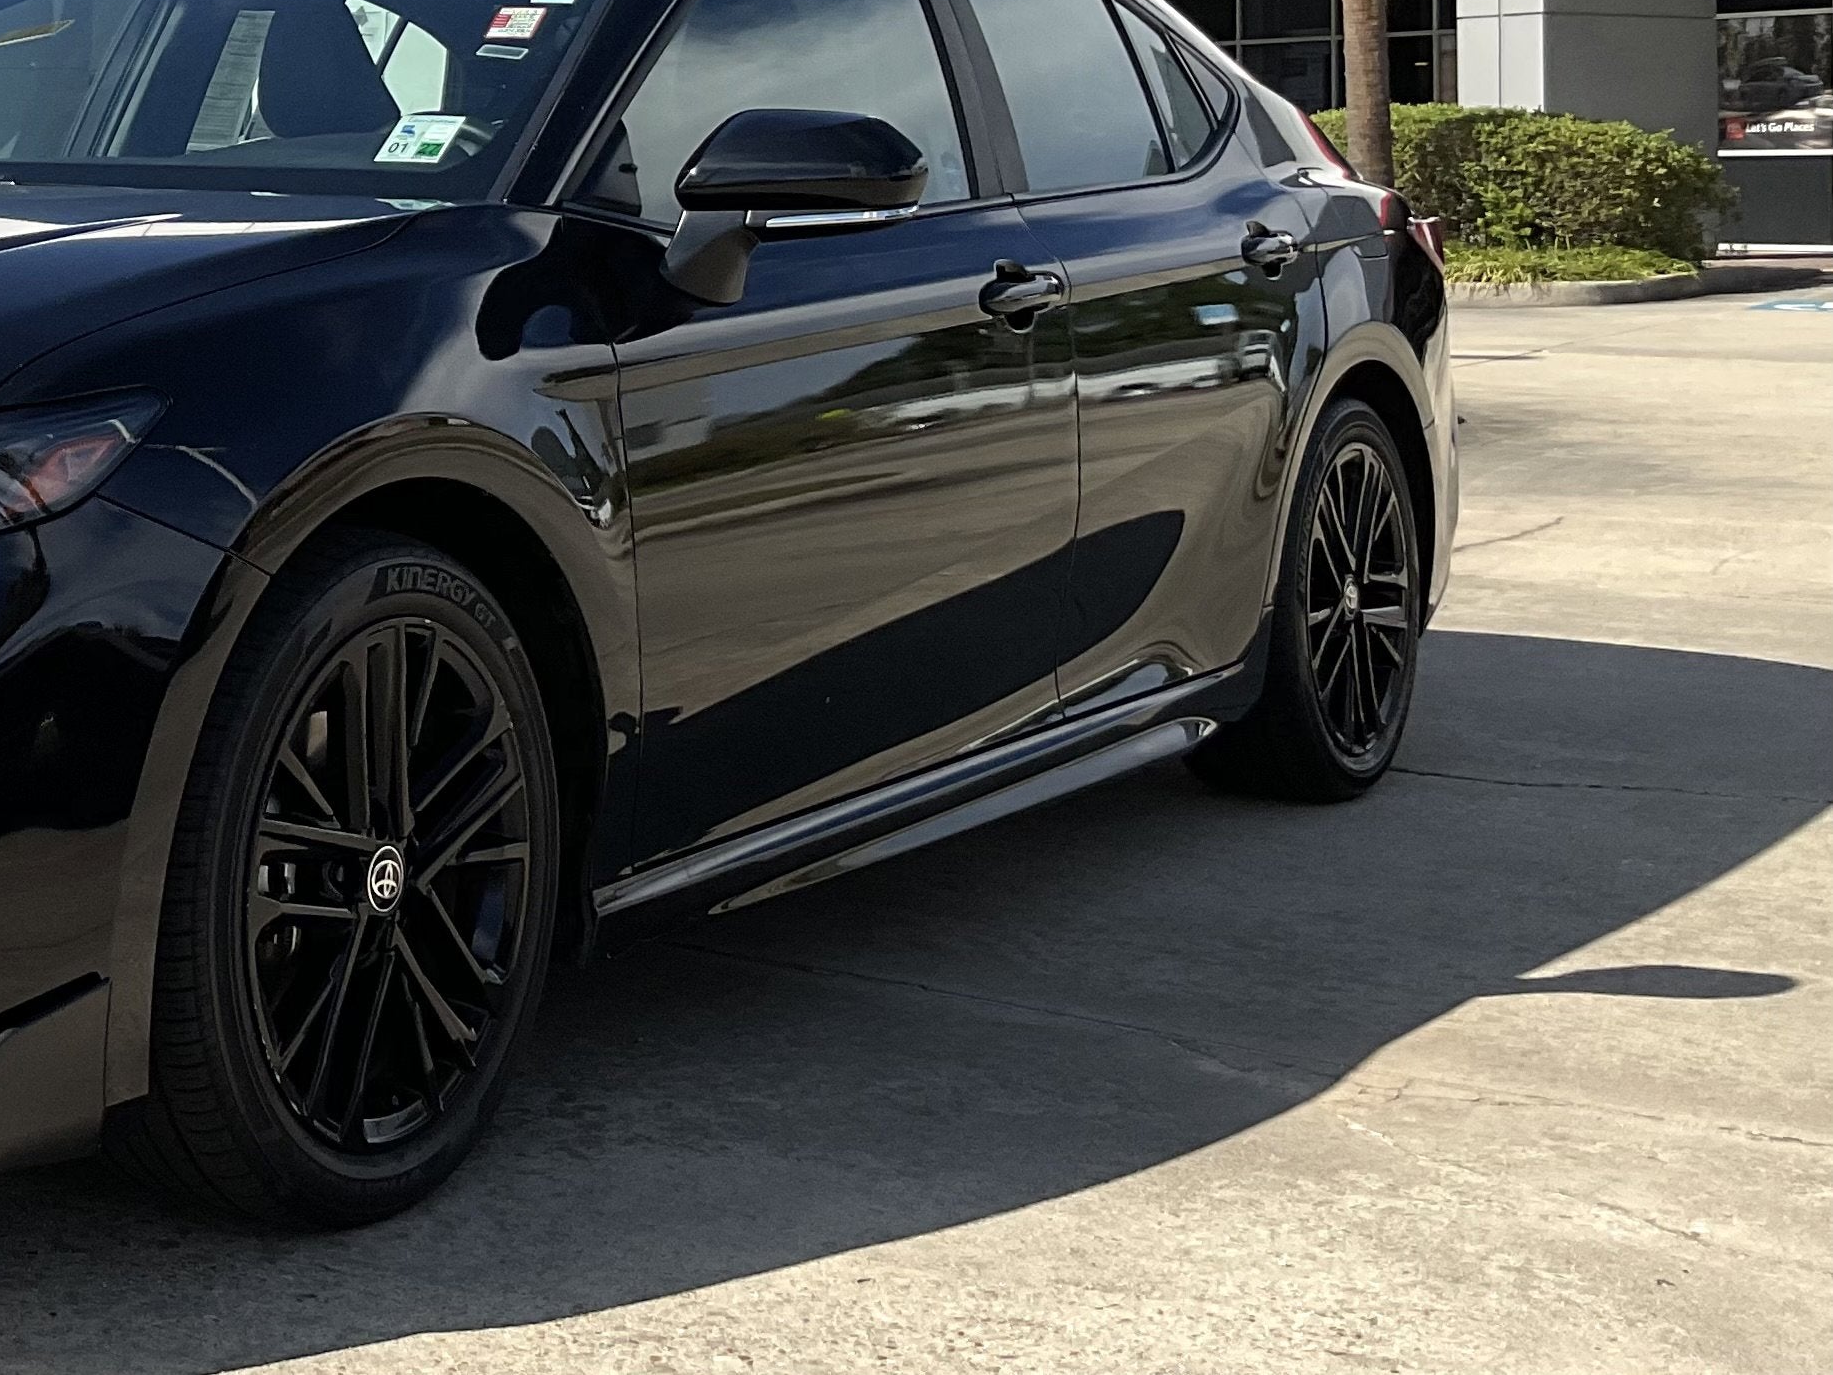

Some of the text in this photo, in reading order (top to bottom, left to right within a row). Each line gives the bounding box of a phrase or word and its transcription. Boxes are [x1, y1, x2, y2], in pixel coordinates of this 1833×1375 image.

[1745, 121, 1815, 133] Let's Go Places
